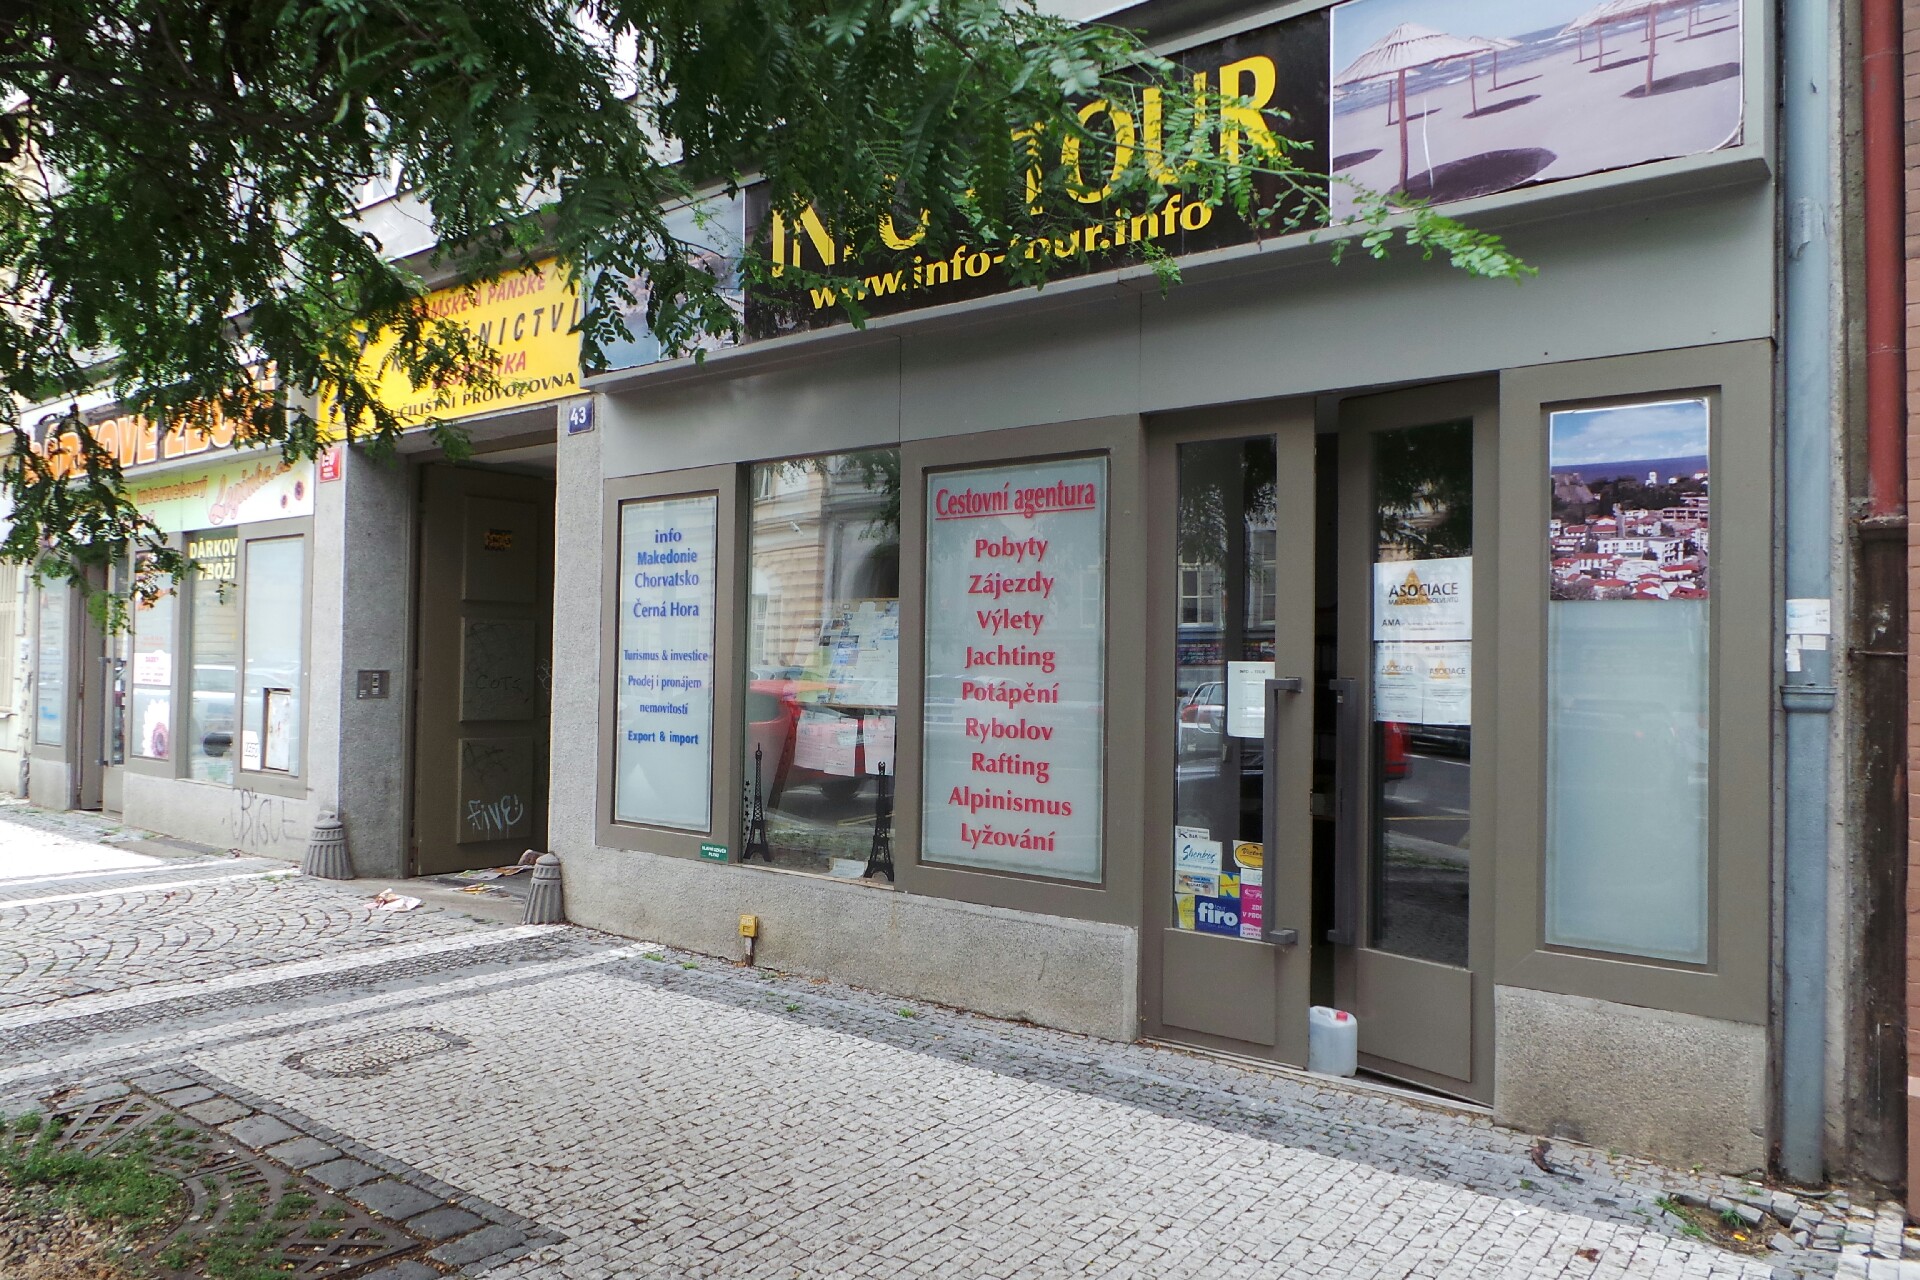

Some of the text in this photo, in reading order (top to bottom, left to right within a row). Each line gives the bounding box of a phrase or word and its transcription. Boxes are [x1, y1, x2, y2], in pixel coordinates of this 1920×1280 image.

[570, 408, 587, 425] 43
[936, 480, 1096, 518] Cestovní agentura
[655, 528, 682, 543] info
[190, 537, 238, 559] DÁRKOV
[637, 548, 698, 565] Makedonie
[975, 536, 1048, 563] Pobyty
[634, 570, 699, 588] Chorvatsko
[968, 571, 1054, 599] Zájezdy
[1389, 583, 1459, 597] ASOCIACE
[633, 598, 699, 618] Černá Hora
[976, 608, 1044, 636] Výlety
[1382, 619, 1400, 627] AMA
[624, 649, 708, 661] Turismus & investice
[964, 645, 1056, 673] Jachting
[1429, 667, 1466, 675] ASOCIACE
[628, 675, 654, 689] Prodej
[661, 676, 702, 691] pronájem
[962, 681, 1059, 709] Potápění
[639, 703, 688, 715] nemovitostí
[628, 730, 699, 745] Export & import
[965, 717, 1054, 743] Rybolov
[971, 752, 1049, 783] Rafting
[948, 786, 1072, 816] Alpinismus
[961, 823, 1056, 852] Lyžování
[1198, 902, 1238, 927] firo
